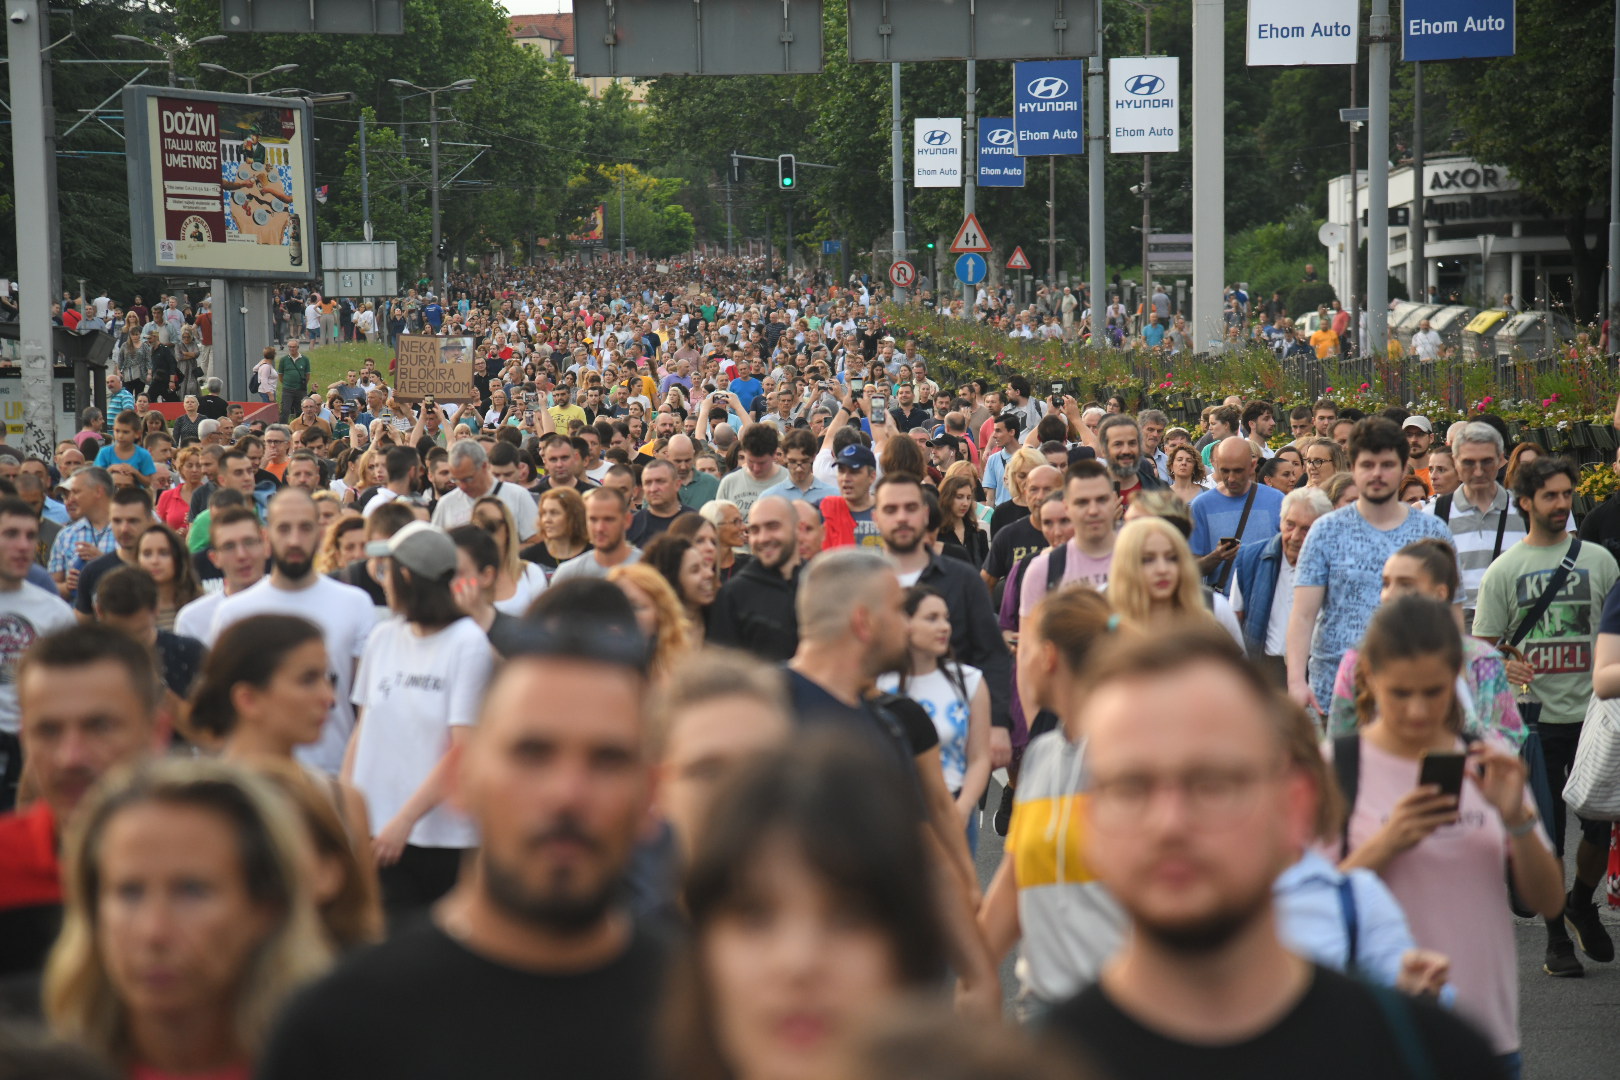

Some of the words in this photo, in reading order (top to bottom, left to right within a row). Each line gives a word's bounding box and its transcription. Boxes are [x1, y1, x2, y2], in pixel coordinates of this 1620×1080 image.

[1258, 23, 1305, 39] Ehom
[1311, 22, 1351, 37] Auto
[1409, 18, 1458, 36] Ehom
[1463, 15, 1505, 32] Auto
[1019, 101, 1078, 112] HYUNDAI
[1116, 99, 1174, 109] HYUNDAI
[163, 106, 216, 137] DOŽIVI
[1019, 130, 1050, 141] Ehom
[1052, 129, 1078, 140] Auto
[1116, 127, 1145, 137] Ehom
[1149, 126, 1174, 137] Auto
[164, 137, 193, 151] ITALIJU
[195, 140, 217, 153] KROZ
[981, 146, 1014, 155] HYUND
[165, 153, 218, 170] UMETNOST
[917, 167, 937, 176] Ehom
[940, 167, 958, 176] Auto
[980, 167, 1001, 176] Ehom
[1003, 167, 1022, 176] Auto
[1430, 168, 1499, 191] AXOR
[400, 340, 436, 355] NEKA
[399, 354, 435, 367] ĐURA
[400, 367, 456, 380] BLOKIRA
[399, 381, 470, 394] AERODROM
[1543, 607, 1564, 632] IT
[1527, 645, 1586, 669] CHILL
